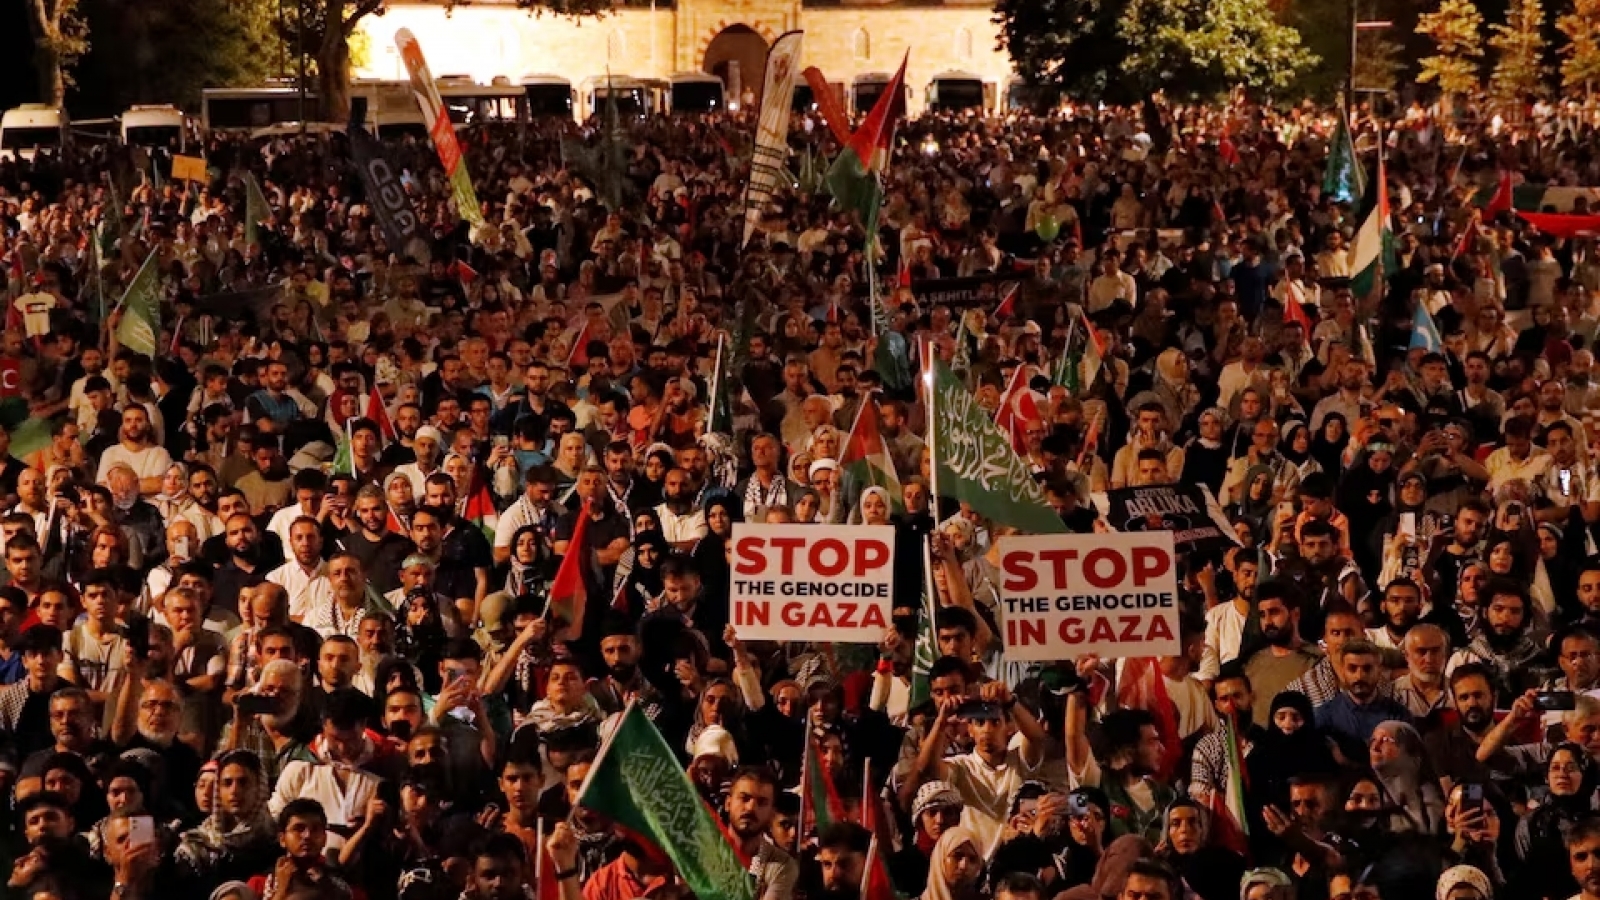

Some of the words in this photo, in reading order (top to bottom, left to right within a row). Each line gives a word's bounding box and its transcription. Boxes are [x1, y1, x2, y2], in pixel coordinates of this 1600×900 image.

[735, 537, 890, 577] STOP
[1002, 546, 1171, 592] STOP
[735, 581, 775, 596] THE
[780, 581, 888, 598] GENOCIDE
[1004, 597, 1049, 613] THE
[1055, 592, 1173, 611] GENOCIDE
[735, 601, 770, 626] IN
[781, 601, 886, 628] GAZA
[1007, 618, 1046, 646] IN
[1058, 614, 1175, 645] GAZA
